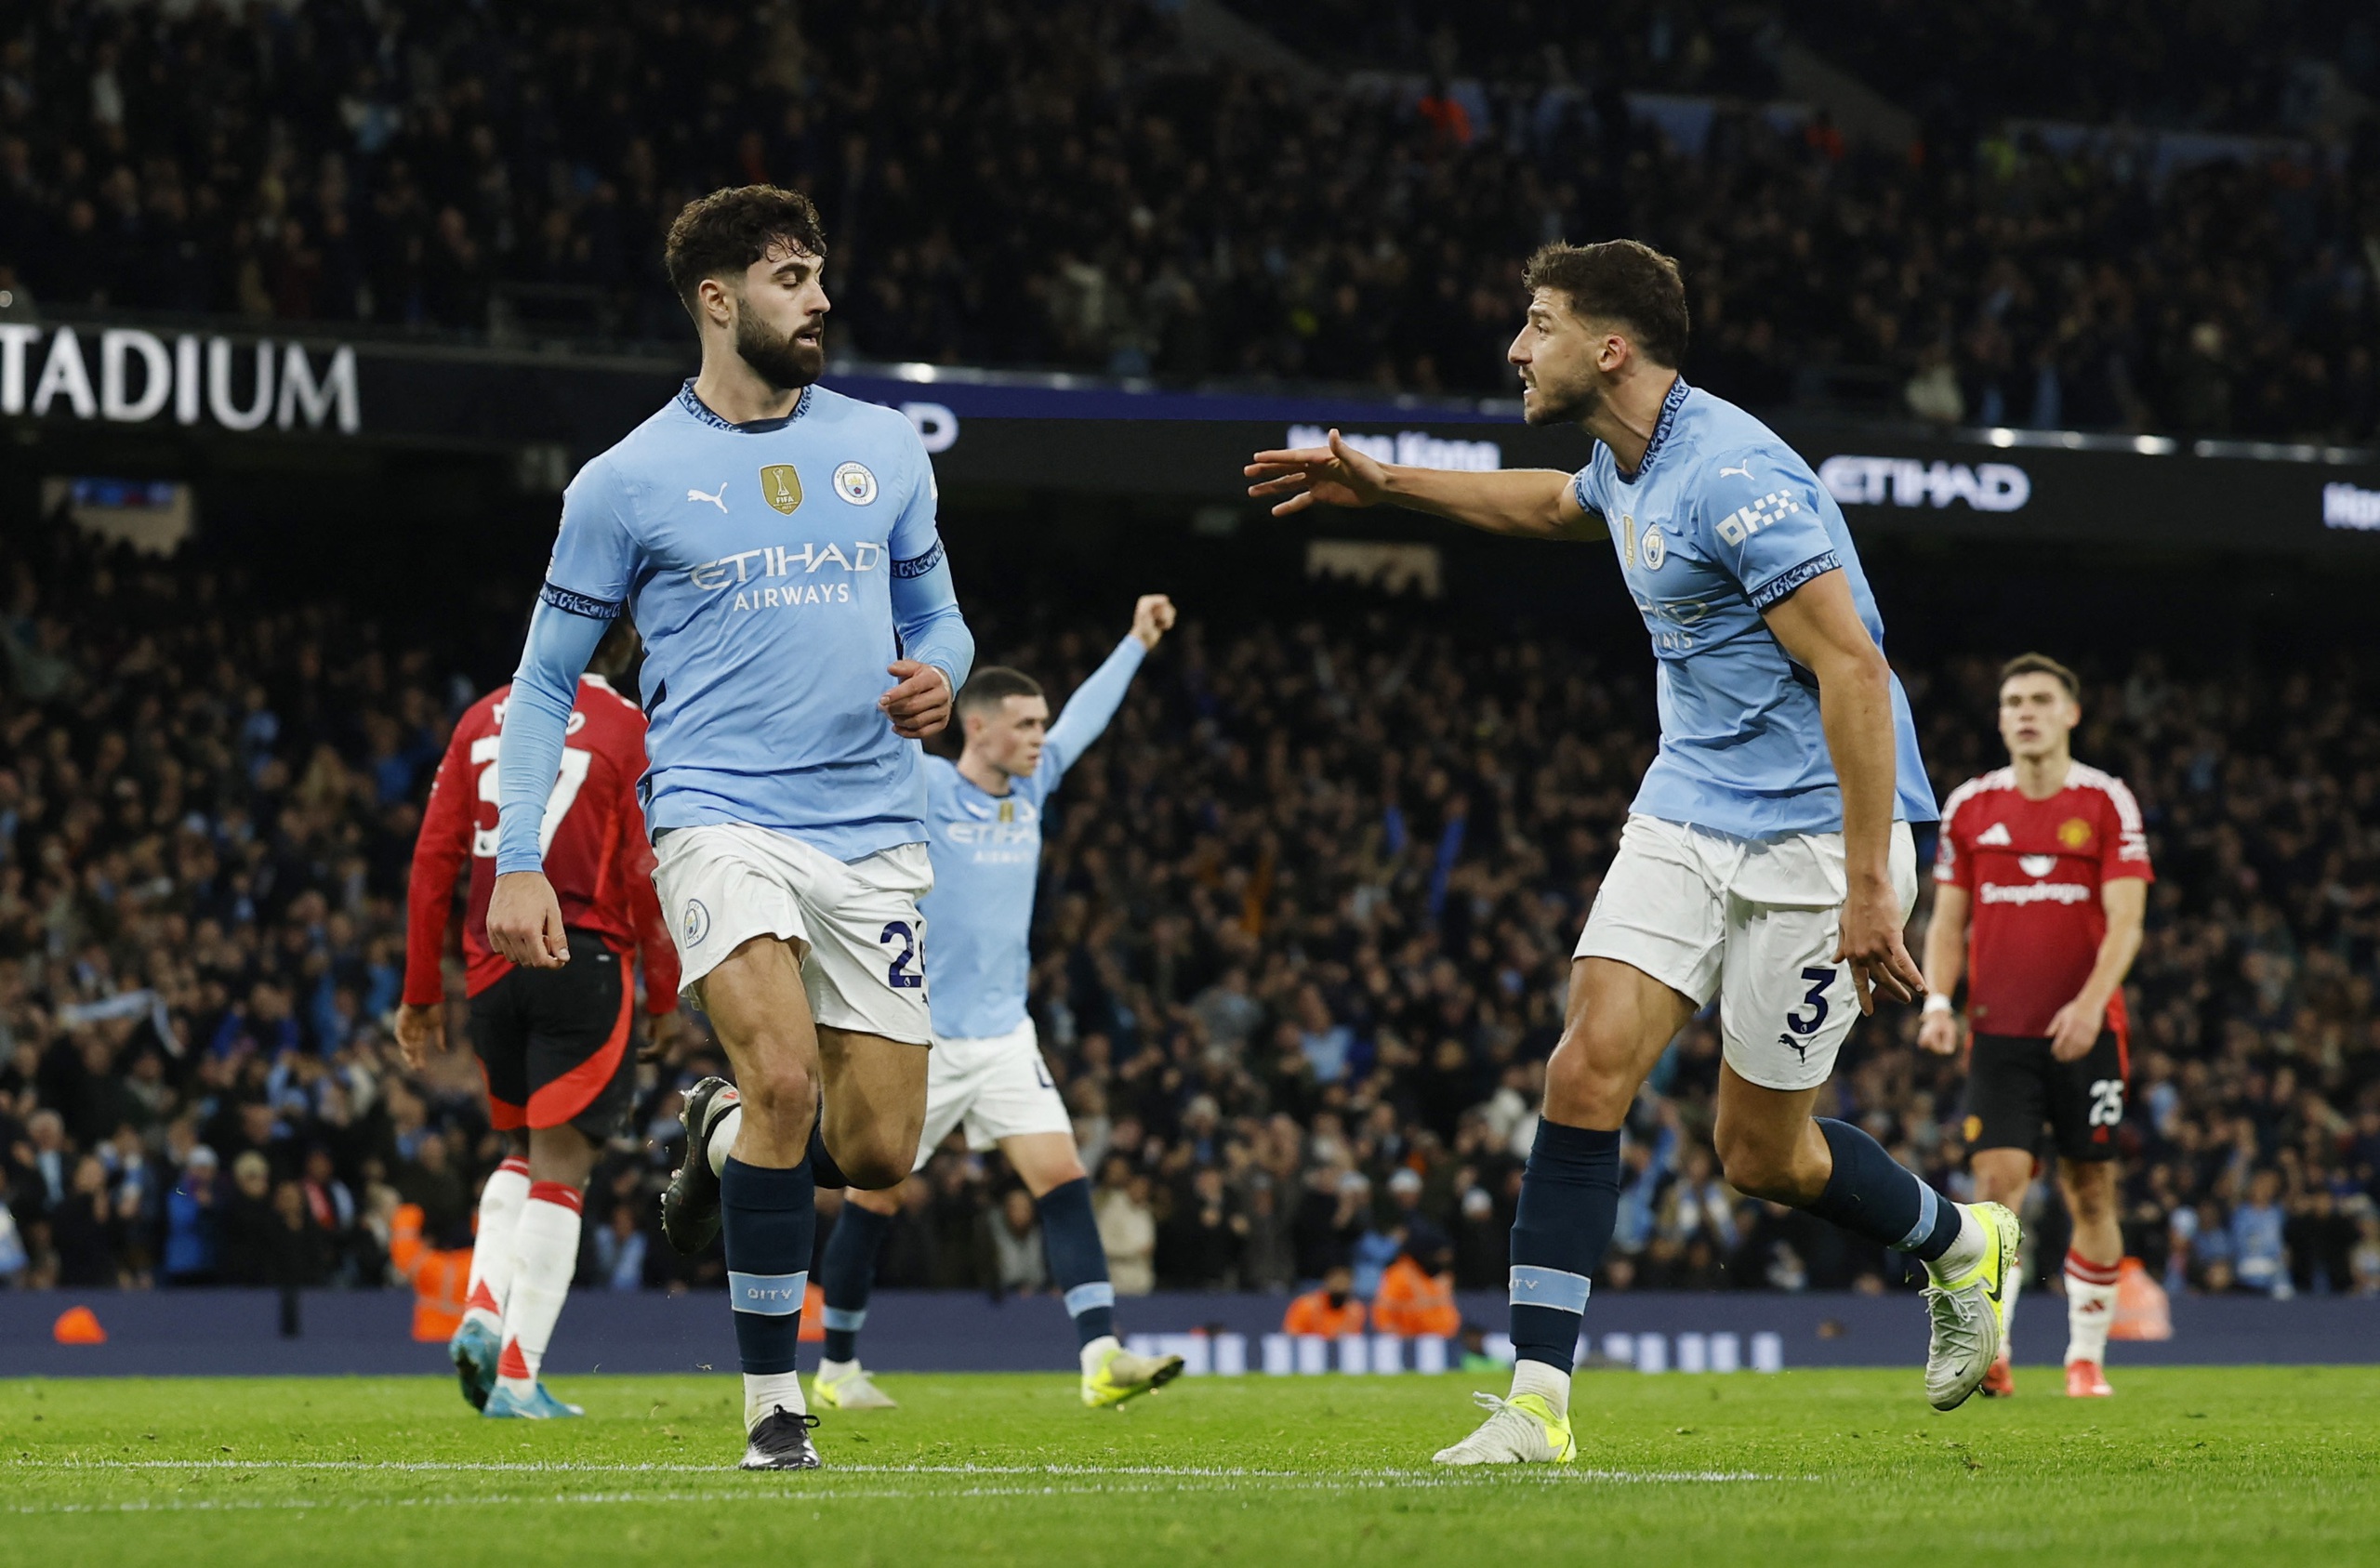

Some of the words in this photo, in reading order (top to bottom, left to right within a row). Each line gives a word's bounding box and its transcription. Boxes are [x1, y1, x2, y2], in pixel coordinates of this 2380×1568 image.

[0, 323, 362, 435] TADIUM
[775, 495, 795, 504] FIFA
[1818, 455, 2030, 511] ETIHAD
[690, 541, 881, 591] ETIHAD
[733, 583, 850, 613] AIRWAYS
[1787, 967, 1837, 1034] 3
[2089, 1078, 2125, 1127] 25
